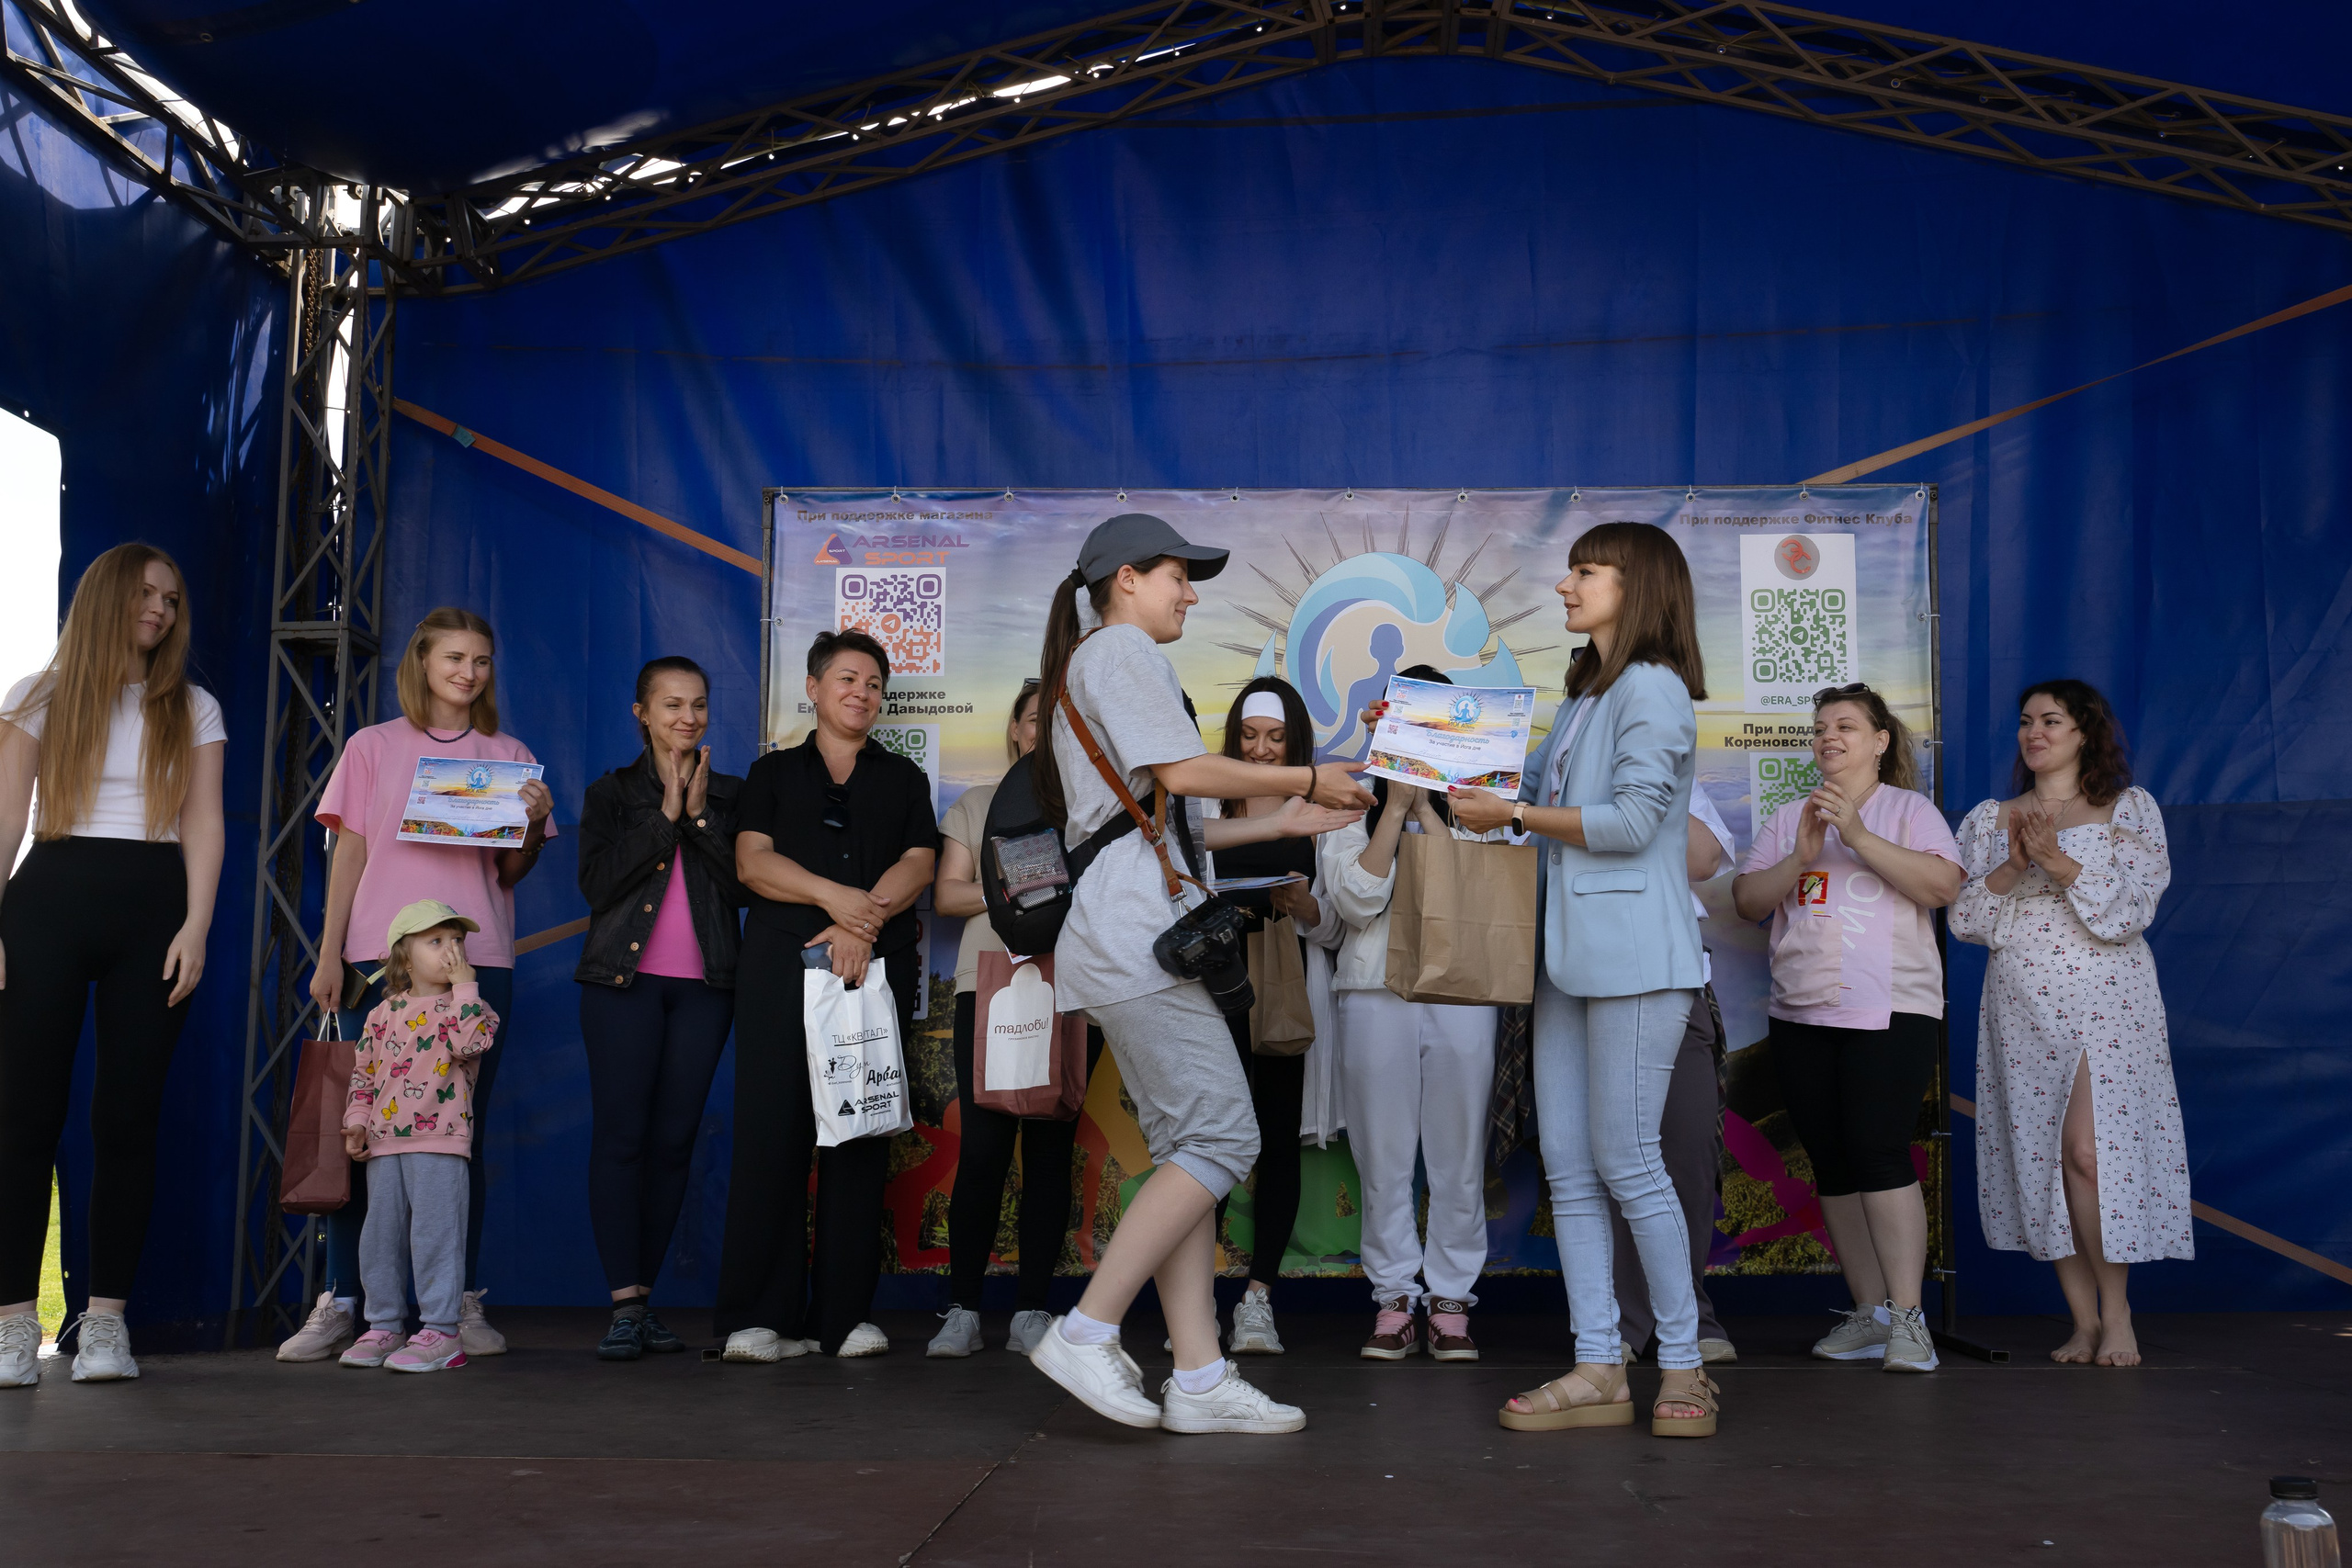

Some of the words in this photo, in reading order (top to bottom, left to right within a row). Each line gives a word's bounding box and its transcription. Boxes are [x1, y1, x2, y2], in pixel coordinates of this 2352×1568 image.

[797, 510, 826, 524] При
[831, 511, 915, 523] поддержке
[920, 511, 993, 521] магазина
[1679, 513, 1709, 527] При
[1713, 515, 1800, 527] поддержке
[1804, 513, 1860, 525] Фитнес
[1865, 513, 1913, 526] Клуба
[852, 535, 970, 548] ARSENAL
[865, 551, 950, 565] SPORT
[882, 691, 946, 702] ддержке
[1760, 695, 1817, 707] @ERA_SP
[887, 703, 974, 715] Давыдовой
[1426, 729, 1490, 745] Благодарность
[1743, 723, 1773, 737] При
[1724, 737, 1814, 750] Кореновско
[831, 1033, 846, 1043] ТЦ
[865, 1066, 901, 1087] Арба
[854, 1091, 899, 1107] ARSENAL
[861, 1100, 892, 1114] SPORT
